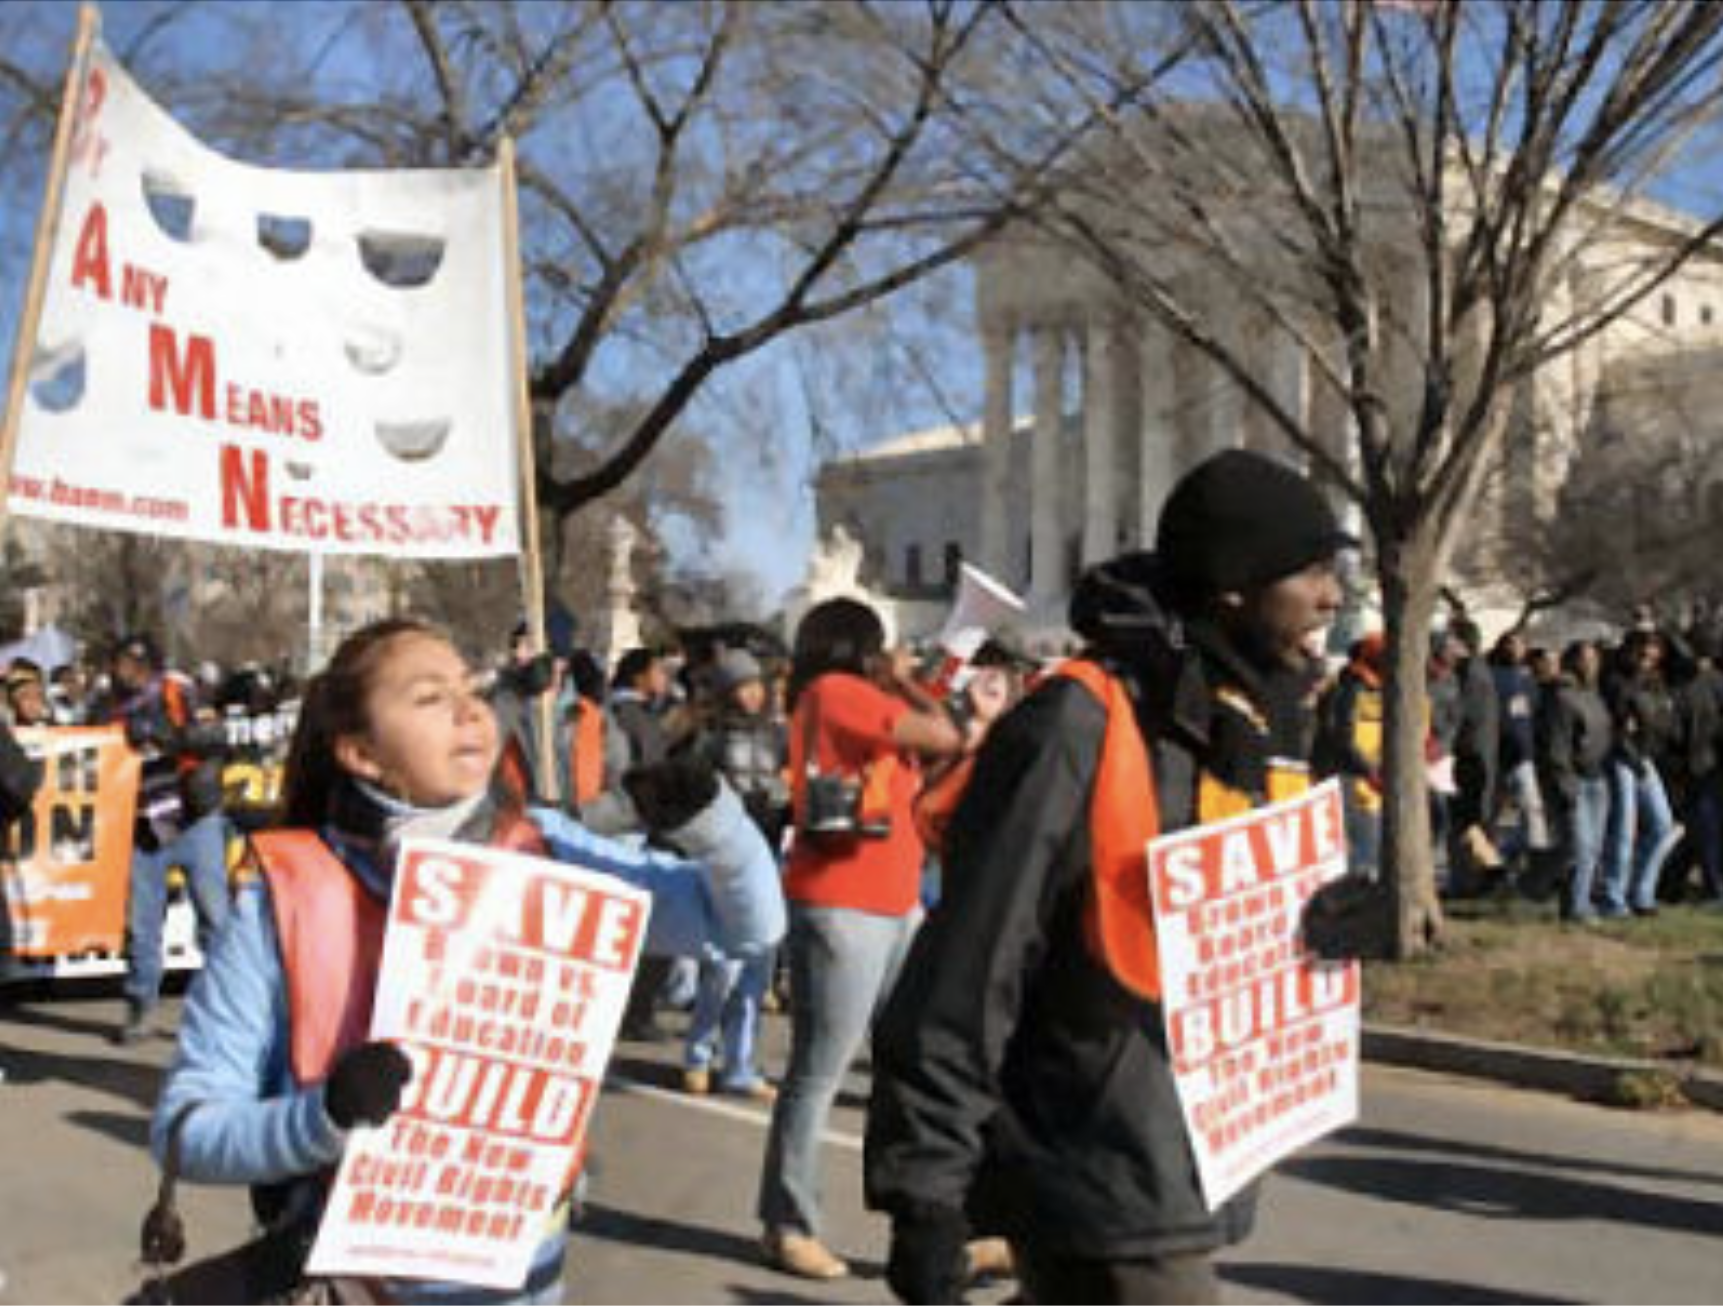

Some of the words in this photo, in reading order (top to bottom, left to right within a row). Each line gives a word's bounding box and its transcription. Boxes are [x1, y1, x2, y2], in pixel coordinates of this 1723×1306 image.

[71, 201, 169, 314] ANY
[148, 322, 323, 441] MEANS
[219, 444, 500, 544] NECESSRY
[1163, 794, 1342, 908] SAVE
[429, 967, 541, 1021] oard
[1181, 967, 1346, 1063] BUILD
[347, 1153, 427, 1192] Civil
[436, 1165, 547, 1212] Rights
[392, 1120, 450, 1160] The
[463, 1134, 531, 1173] New
[347, 1191, 523, 1240] Movement
